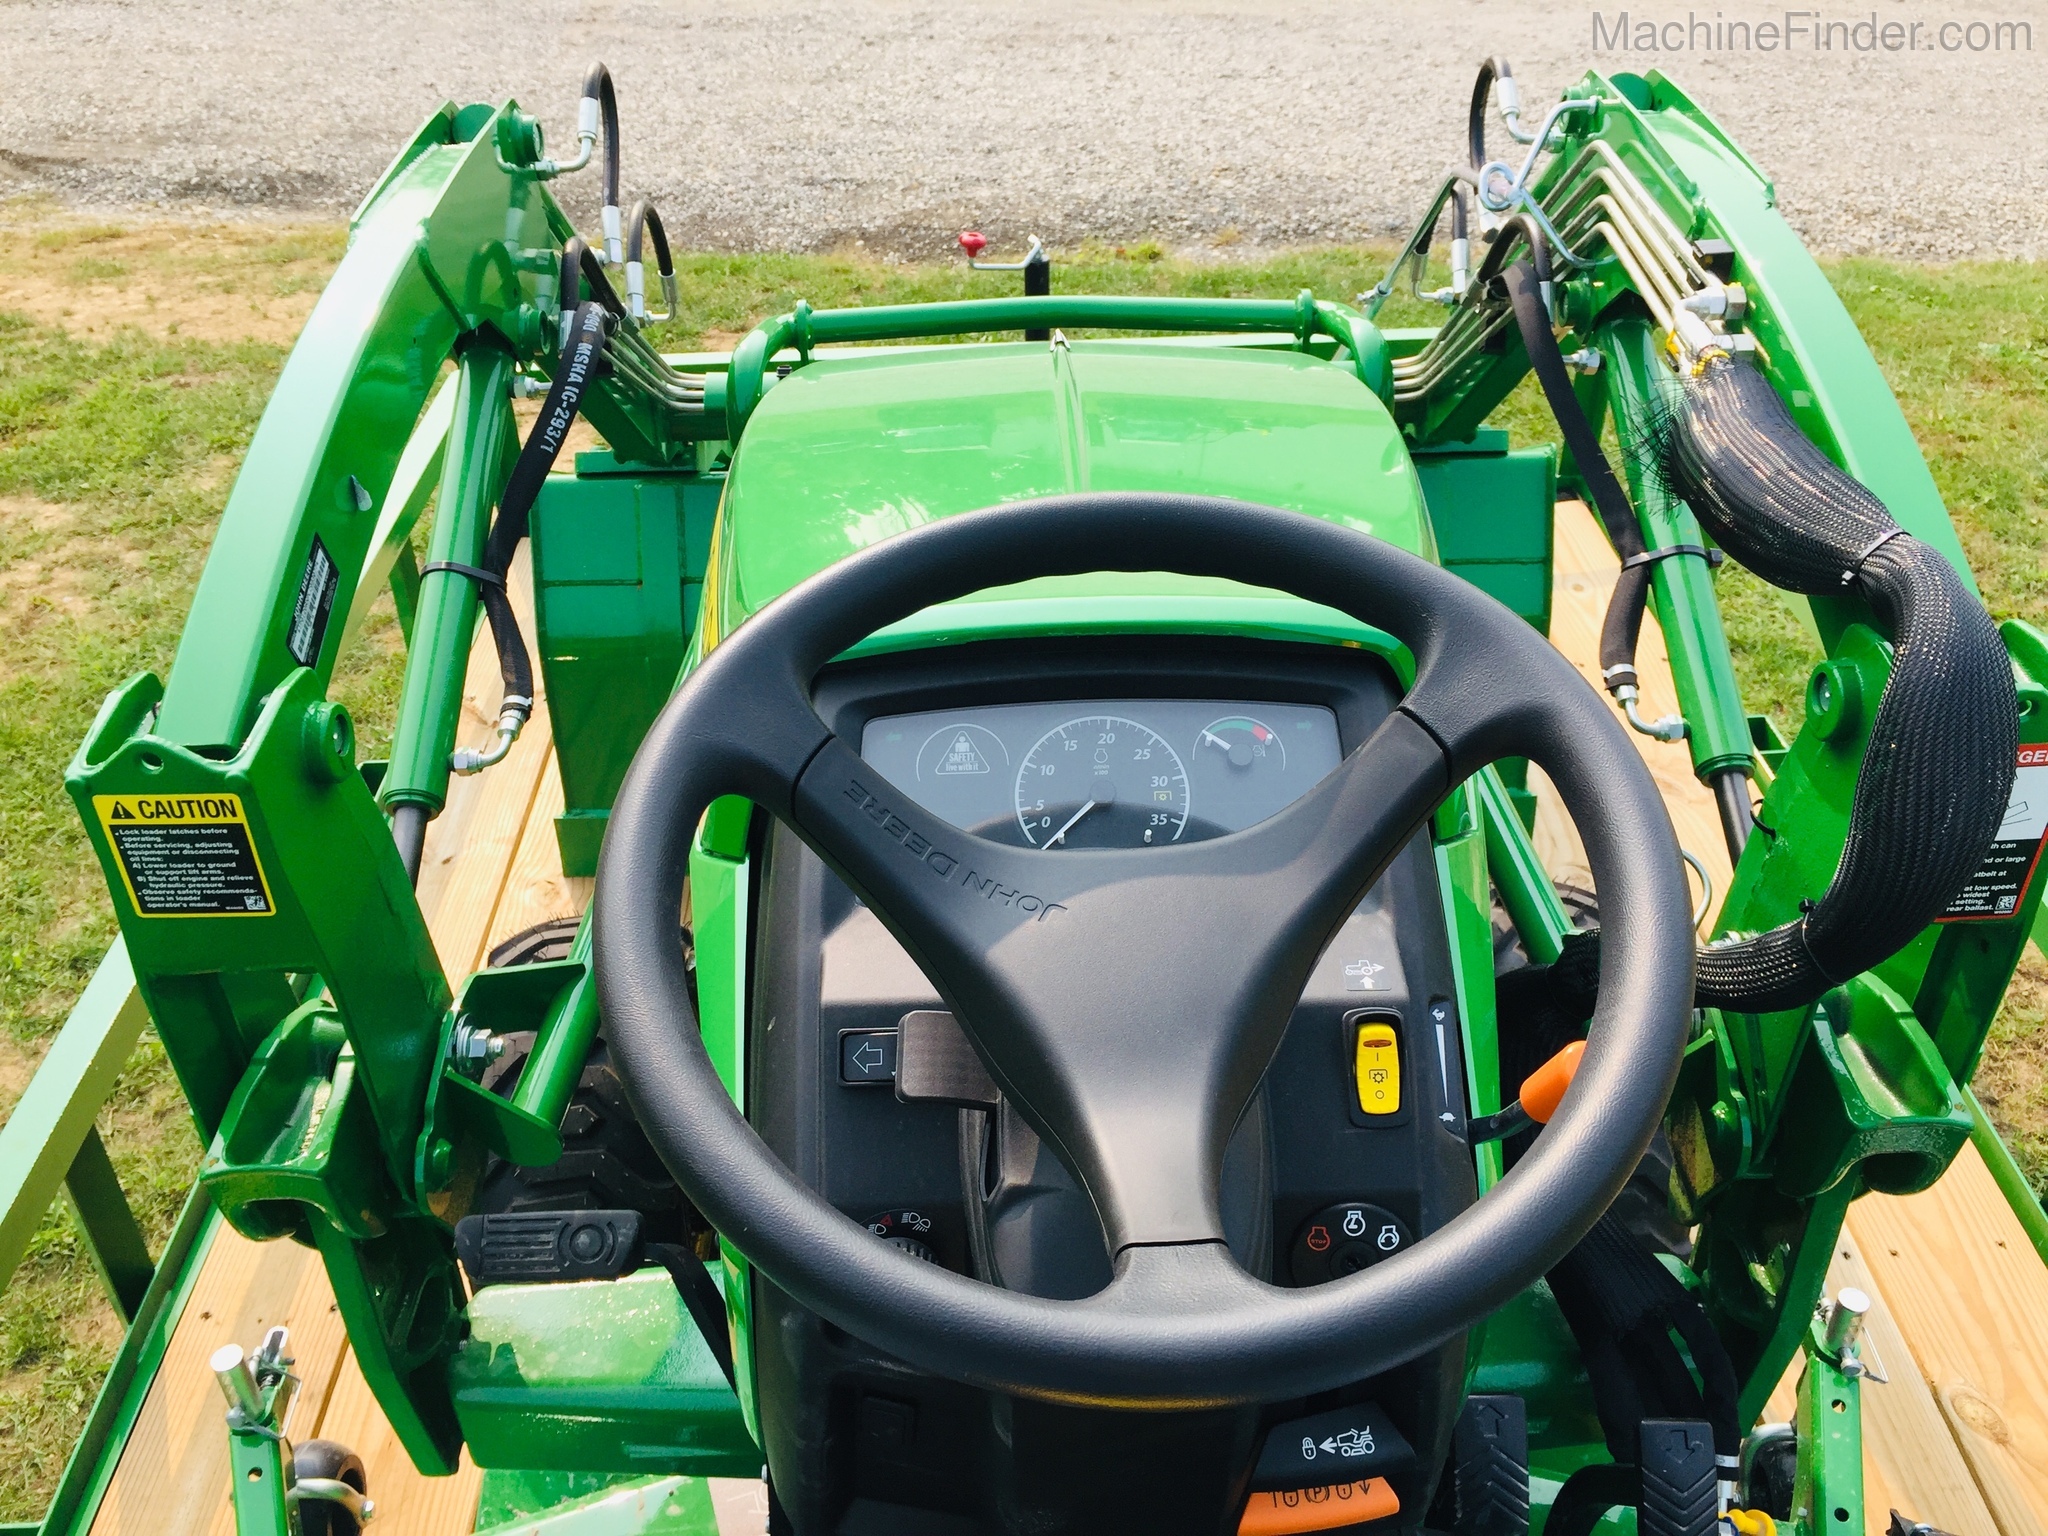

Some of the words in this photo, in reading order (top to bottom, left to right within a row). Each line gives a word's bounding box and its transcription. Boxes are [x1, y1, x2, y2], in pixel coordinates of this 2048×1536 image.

[567, 342, 593, 383] MSHA
[540, 385, 580, 454] IC-293/1
[1097, 732, 1116, 745] 20
[1063, 740, 1078, 751] 15
[949, 752, 975, 761] SAFETY
[1133, 748, 1151, 760] 25
[945, 762, 958, 771] live
[958, 762, 973, 771] with
[973, 762, 979, 771] it
[1040, 764, 1055, 776] 10
[1150, 775, 1169, 787] 30
[138, 799, 238, 819] CAUTION
[1035, 799, 1045, 811] 5
[1041, 816, 1051, 828] 0
[1150, 814, 1168, 826] 35
[843, 779, 960, 882] DEERE
[1991, 883, 2017, 891] speed.
[961, 870, 1069, 922] JOHN
